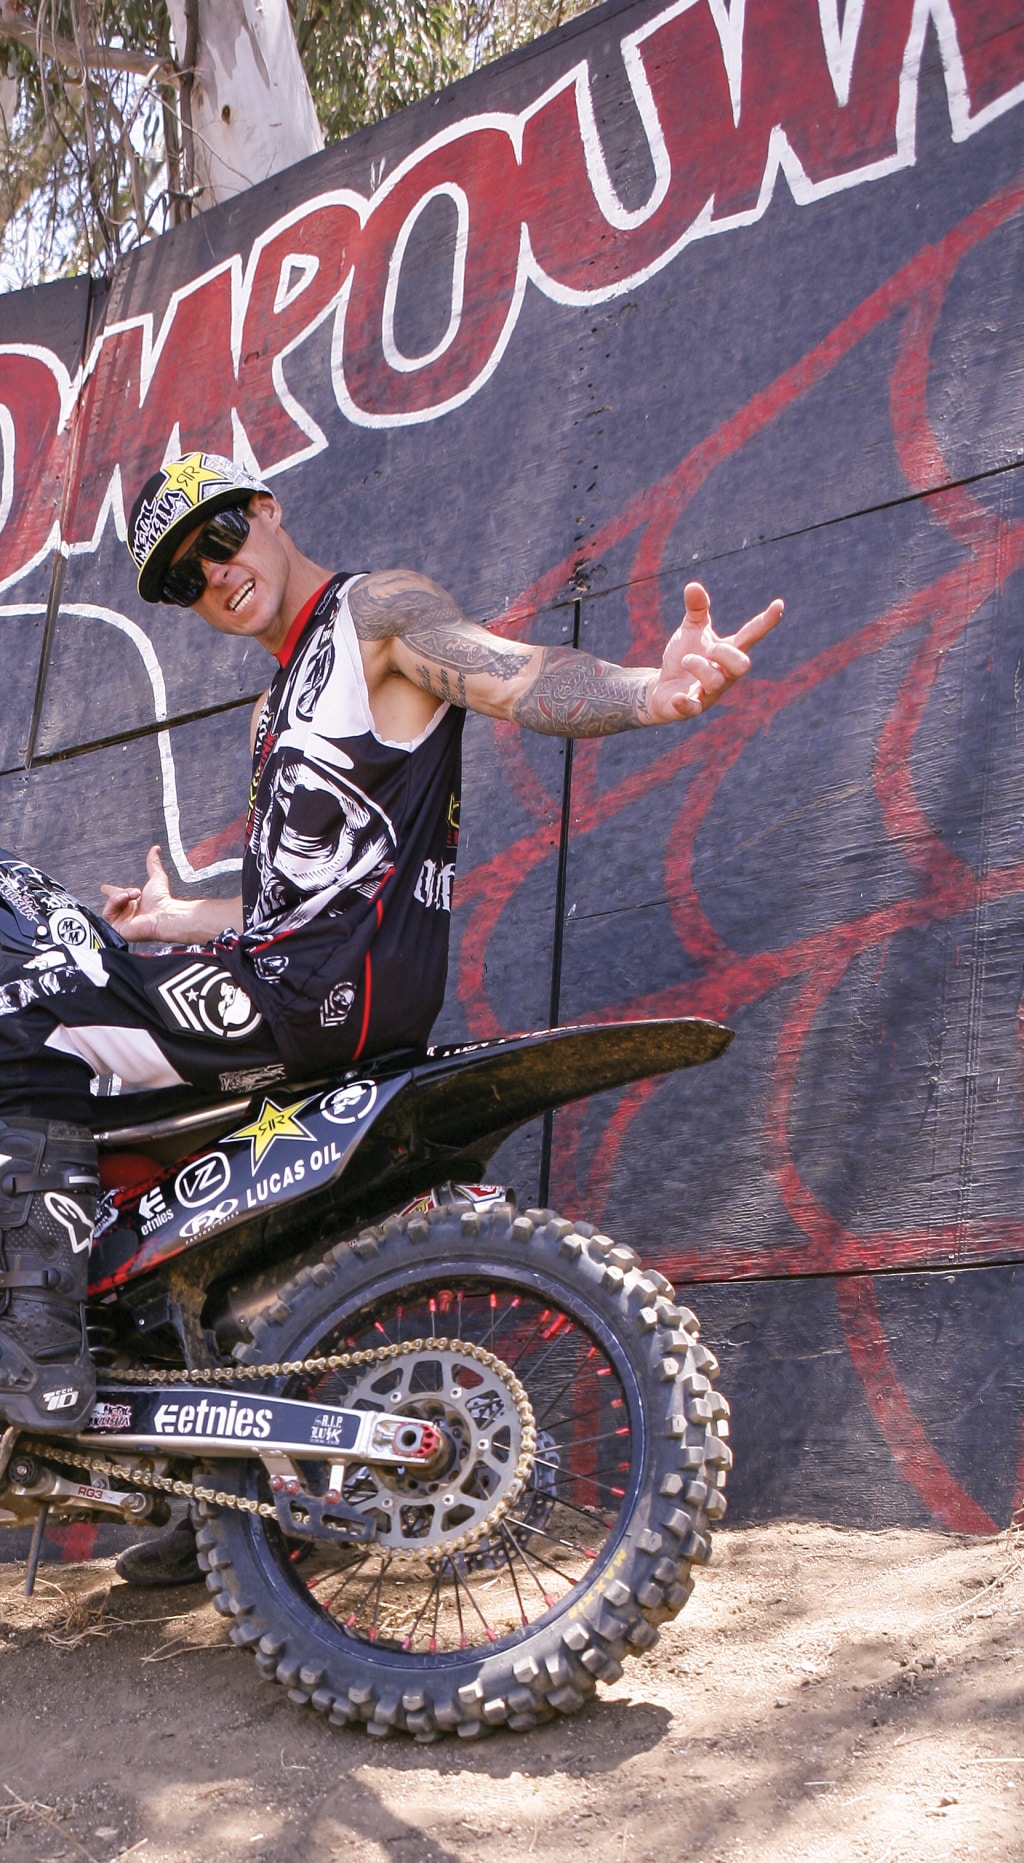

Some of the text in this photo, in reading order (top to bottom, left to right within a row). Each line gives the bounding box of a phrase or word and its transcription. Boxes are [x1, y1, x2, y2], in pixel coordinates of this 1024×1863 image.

[246, 1141, 341, 1208] LUCAS OIL
[140, 1208, 174, 1236] etnies
[77, 1486, 104, 1499] RG3
